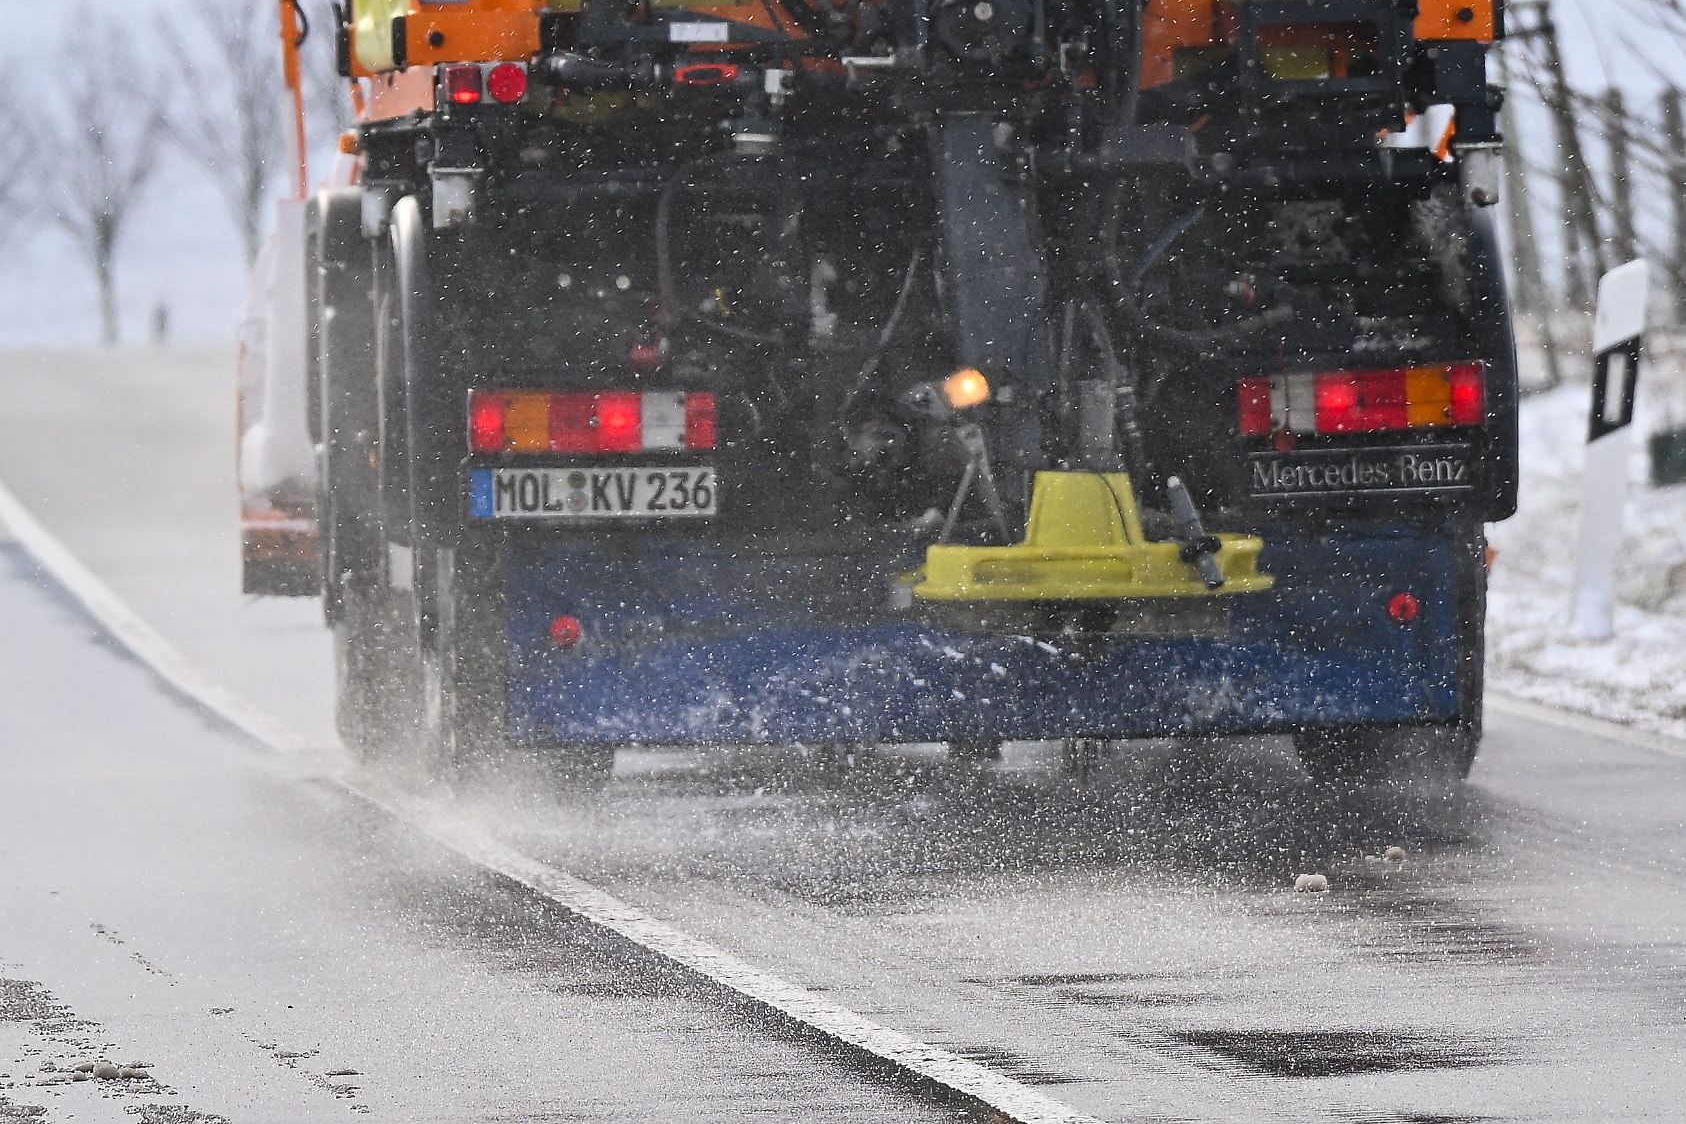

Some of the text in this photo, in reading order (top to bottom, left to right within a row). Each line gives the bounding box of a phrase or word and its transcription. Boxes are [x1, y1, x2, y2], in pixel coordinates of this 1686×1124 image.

[496, 471, 712, 512] MOL KV 236
